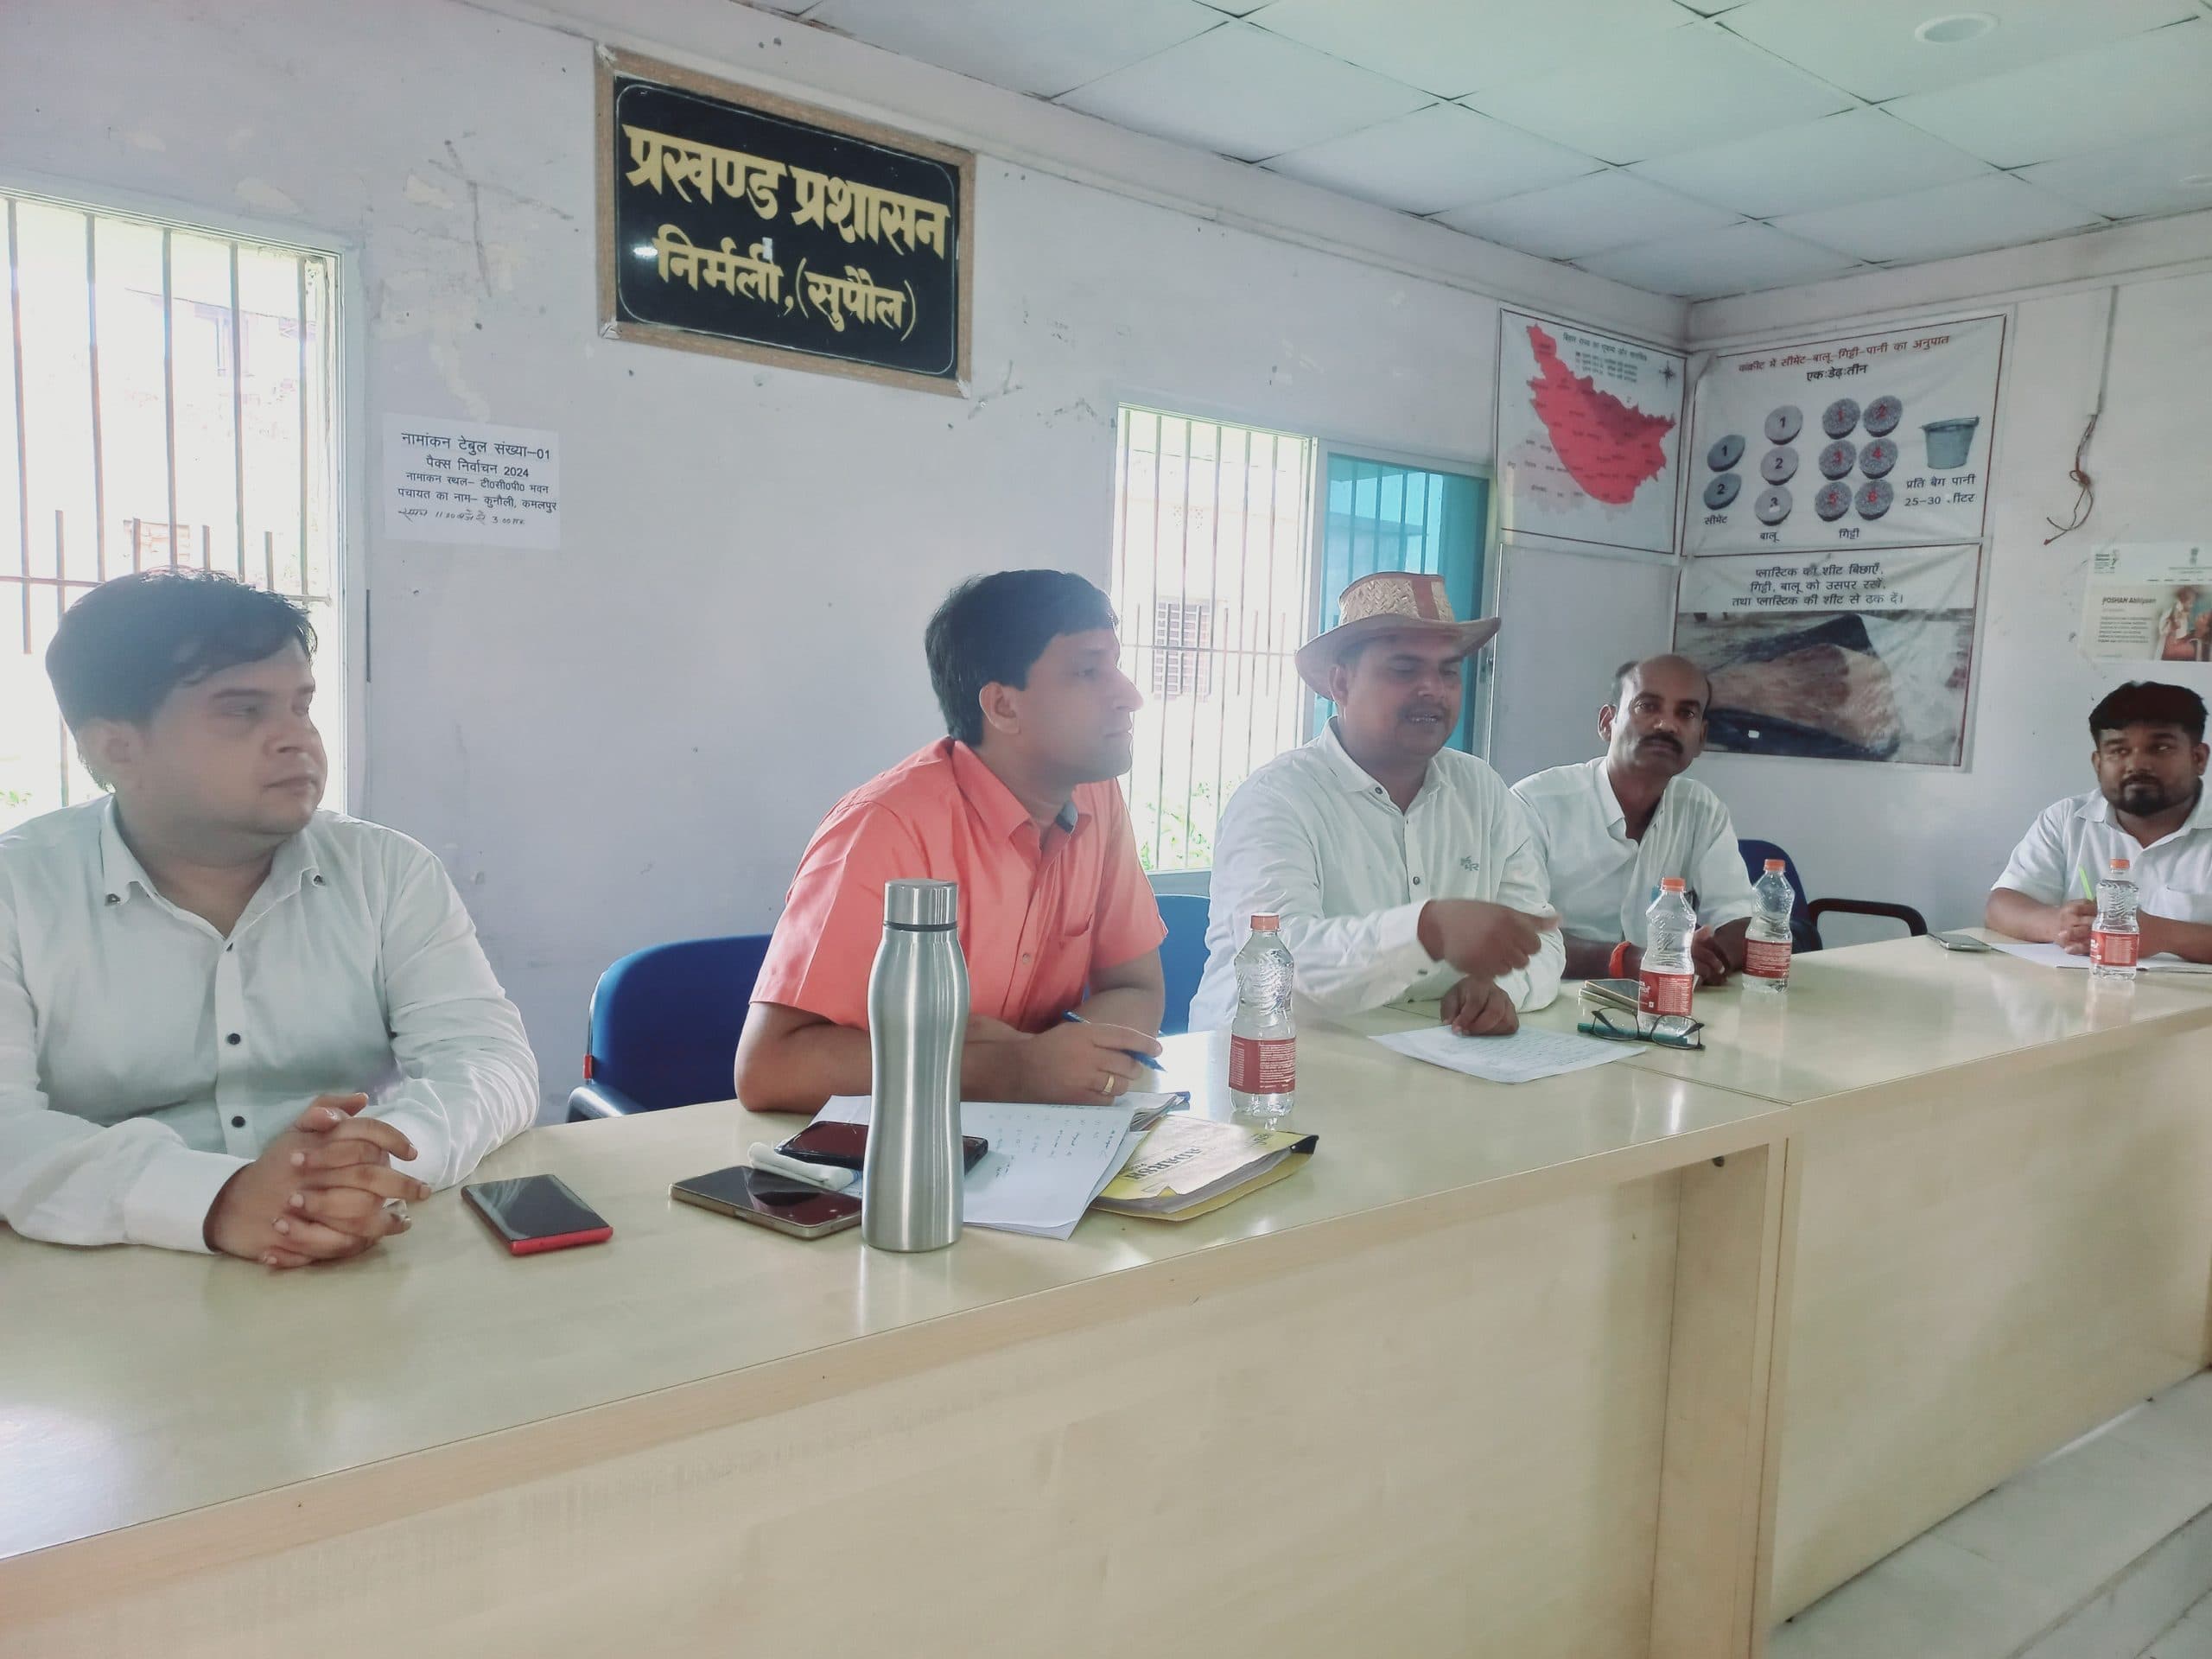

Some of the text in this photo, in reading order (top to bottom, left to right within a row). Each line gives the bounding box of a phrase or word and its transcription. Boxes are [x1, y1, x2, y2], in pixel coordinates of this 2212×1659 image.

[622, 124, 950, 259] प्रखण्ड प्रशासन
[1894, 341, 1907, 351] का
[1913, 335, 1950, 350] अनुपात
[1779, 416, 1786, 428] 1
[401, 432, 451, 448] नामांकन
[458, 435, 486, 455] टेबुल
[1721, 445, 1727, 456] 1
[1872, 447, 1883, 459] 4
[426, 454, 529, 477] पैक्स निर्वाचन 2024
[1775, 458, 1783, 469] 2
[1906, 477, 1925, 488] प्रति
[1952, 474, 1976, 485] पानी
[1717, 484, 1726, 495] 2
[435, 491, 448, 500] का
[522, 499, 557, 513] कमलपुर
[1760, 531, 1780, 543] बालू
[1756, 567, 1797, 578] प्लास्टिक
[1802, 566, 1818, 576] की
[1822, 564, 1843, 576] शीट
[1781, 581, 1802, 594] बालू
[1806, 579, 1820, 591] को
[1826, 580, 1857, 590] उसपर
[1732, 597, 1751, 606] तथा
[1757, 594, 1798, 606] प्लास्टिक
[1803, 594, 1819, 605] की
[1823, 594, 1843, 605] शीट
[1849, 593, 1860, 605] से
